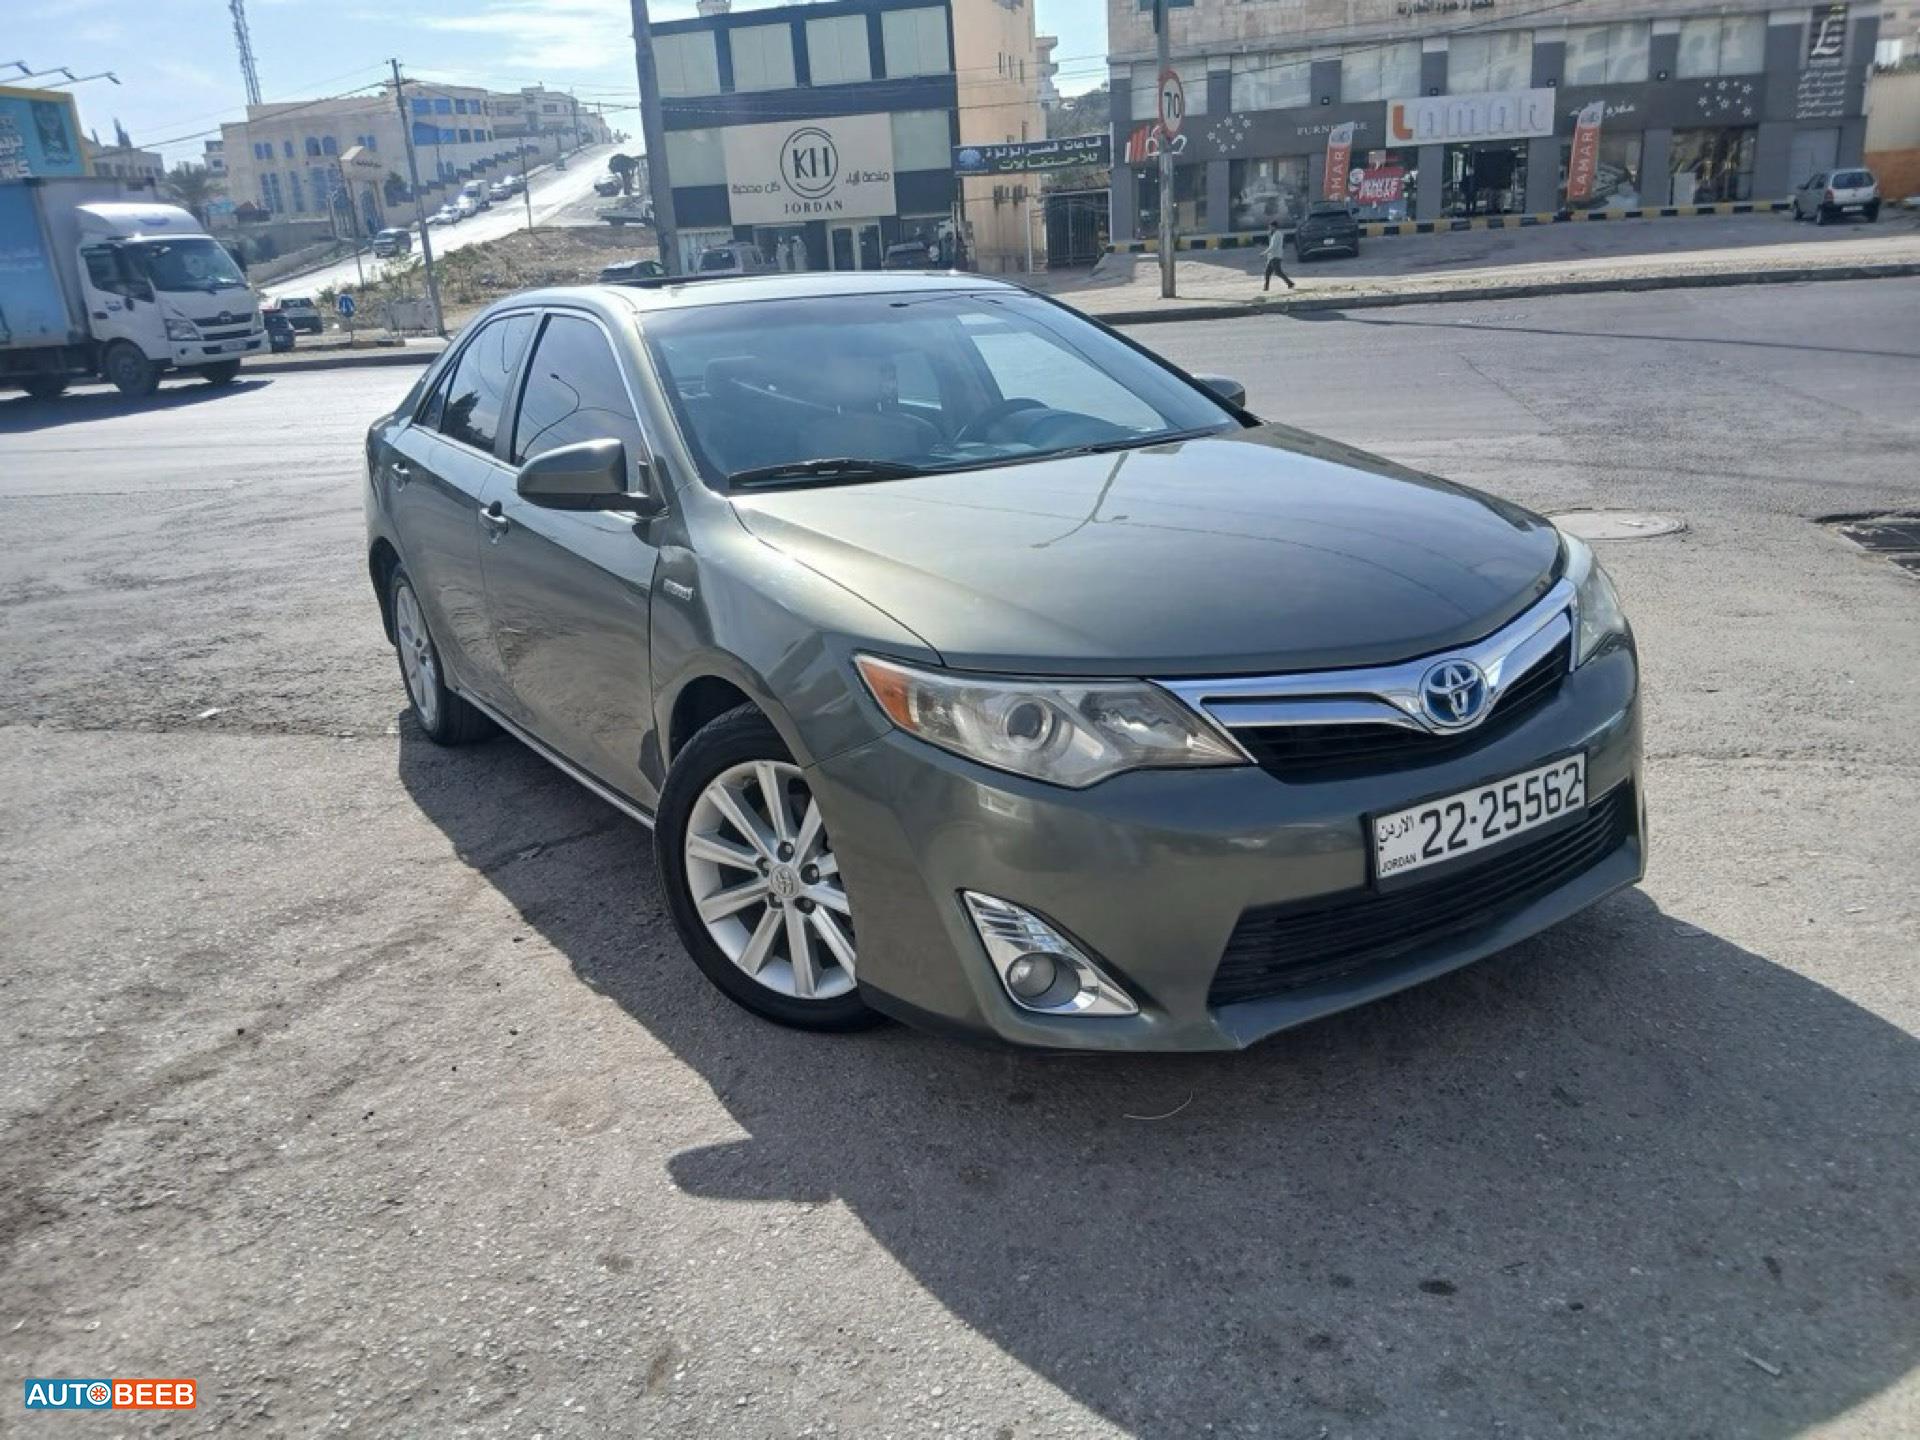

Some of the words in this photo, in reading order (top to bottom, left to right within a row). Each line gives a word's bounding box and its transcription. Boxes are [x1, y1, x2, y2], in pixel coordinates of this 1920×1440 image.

[1163, 91, 1180, 119] 70
[1329, 150, 1346, 201] AMAR
[784, 199, 843, 214] JORDAN
[1420, 762, 1582, 860] 22-25562
[1382, 852, 1417, 873] JORDAN
